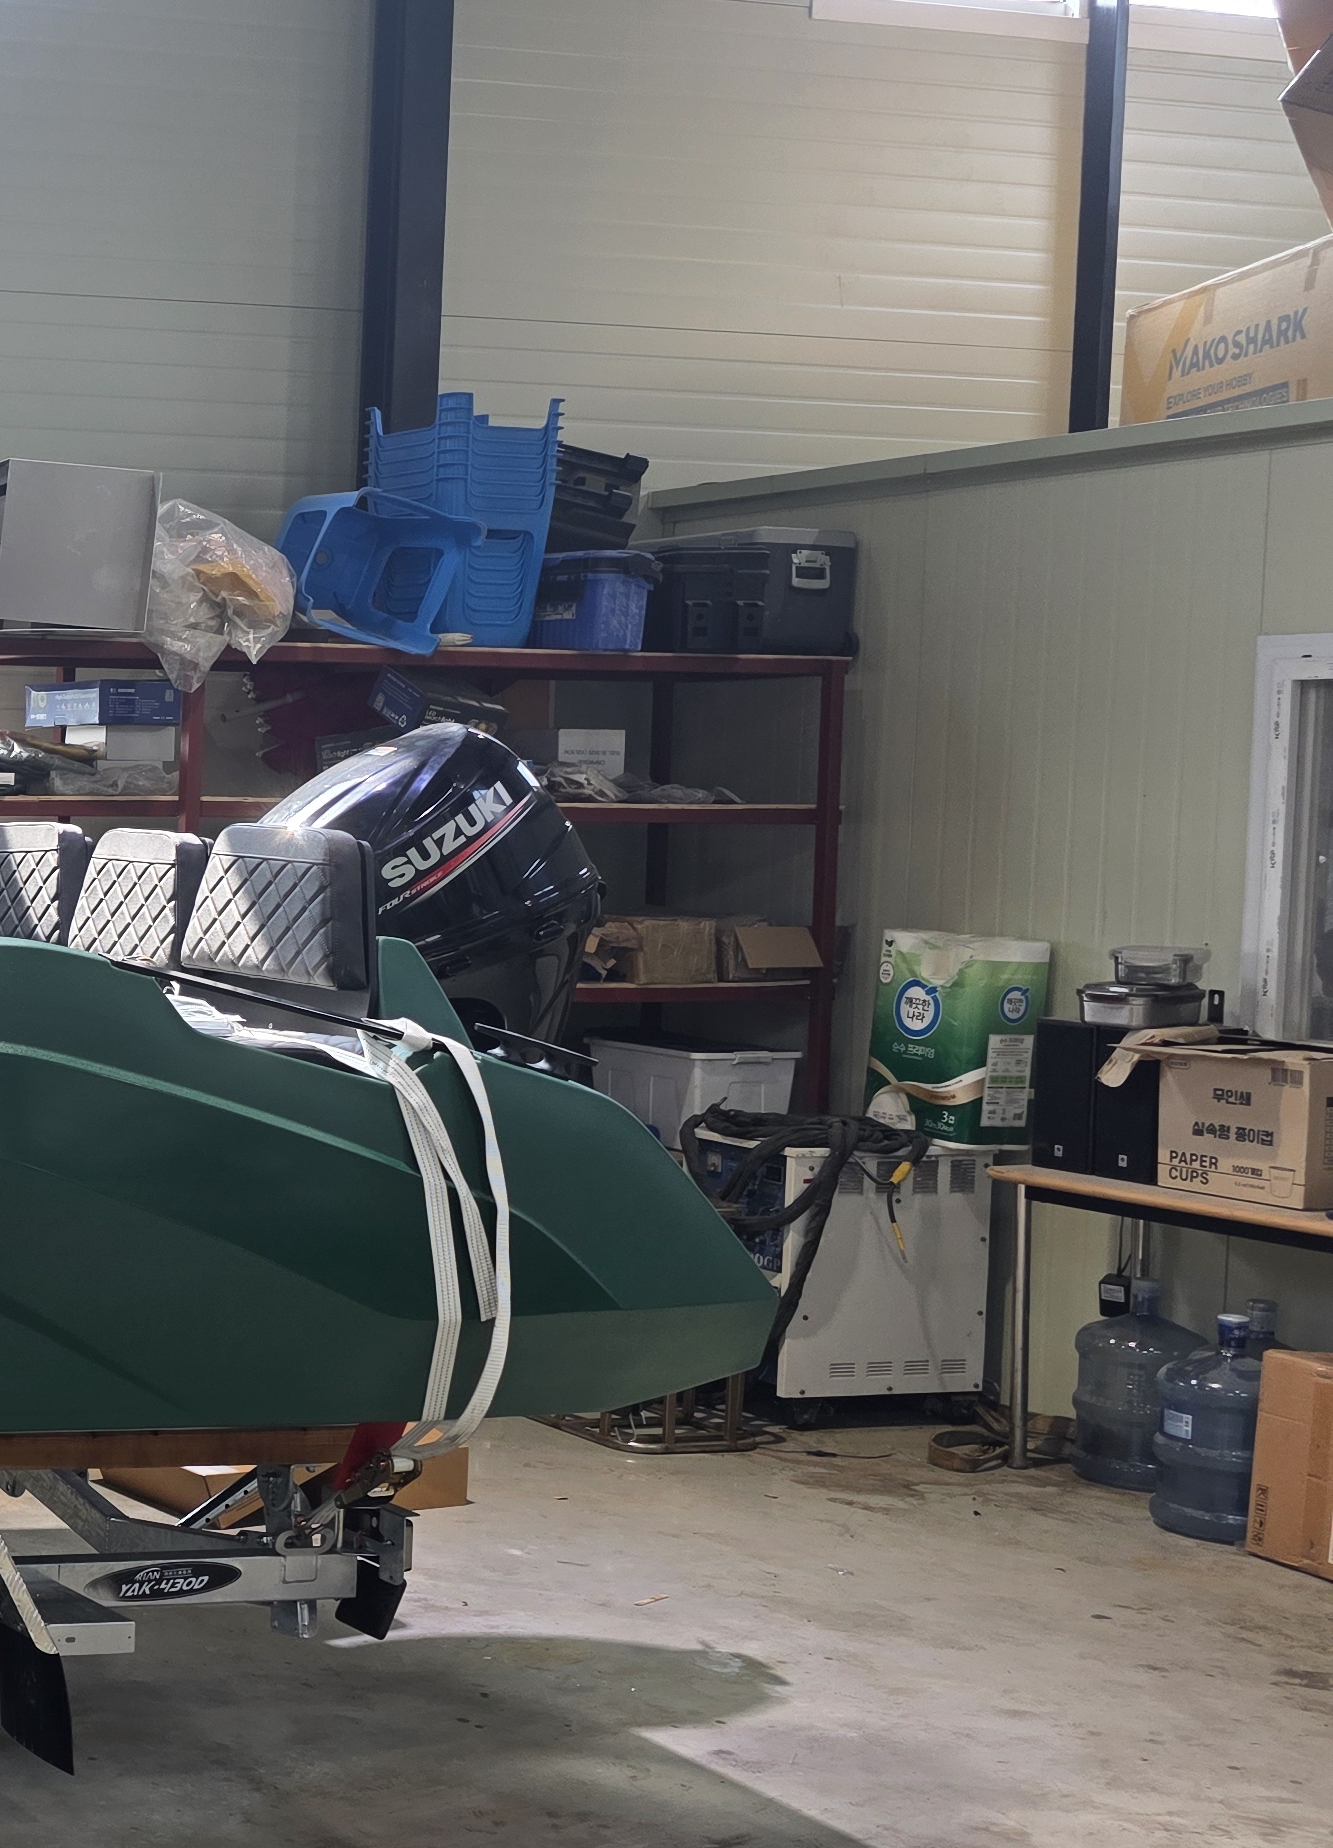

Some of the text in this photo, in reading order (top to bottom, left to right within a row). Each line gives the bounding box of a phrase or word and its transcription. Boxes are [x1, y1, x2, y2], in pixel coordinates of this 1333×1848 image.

[381, 780, 513, 888] SUZUKI
[378, 889, 411, 915] FOUR
[904, 996, 931, 1012] 깨끗한
[906, 1010, 926, 1024] 나라
[1211, 1087, 1252, 1107] 무인쇄
[1191, 1121, 1274, 1147] 실속형 종이컵
[1169, 1149, 1219, 1170] PAPER
[1168, 1166, 1210, 1185] CUPS
[133, 1567, 161, 1581] RIAN
